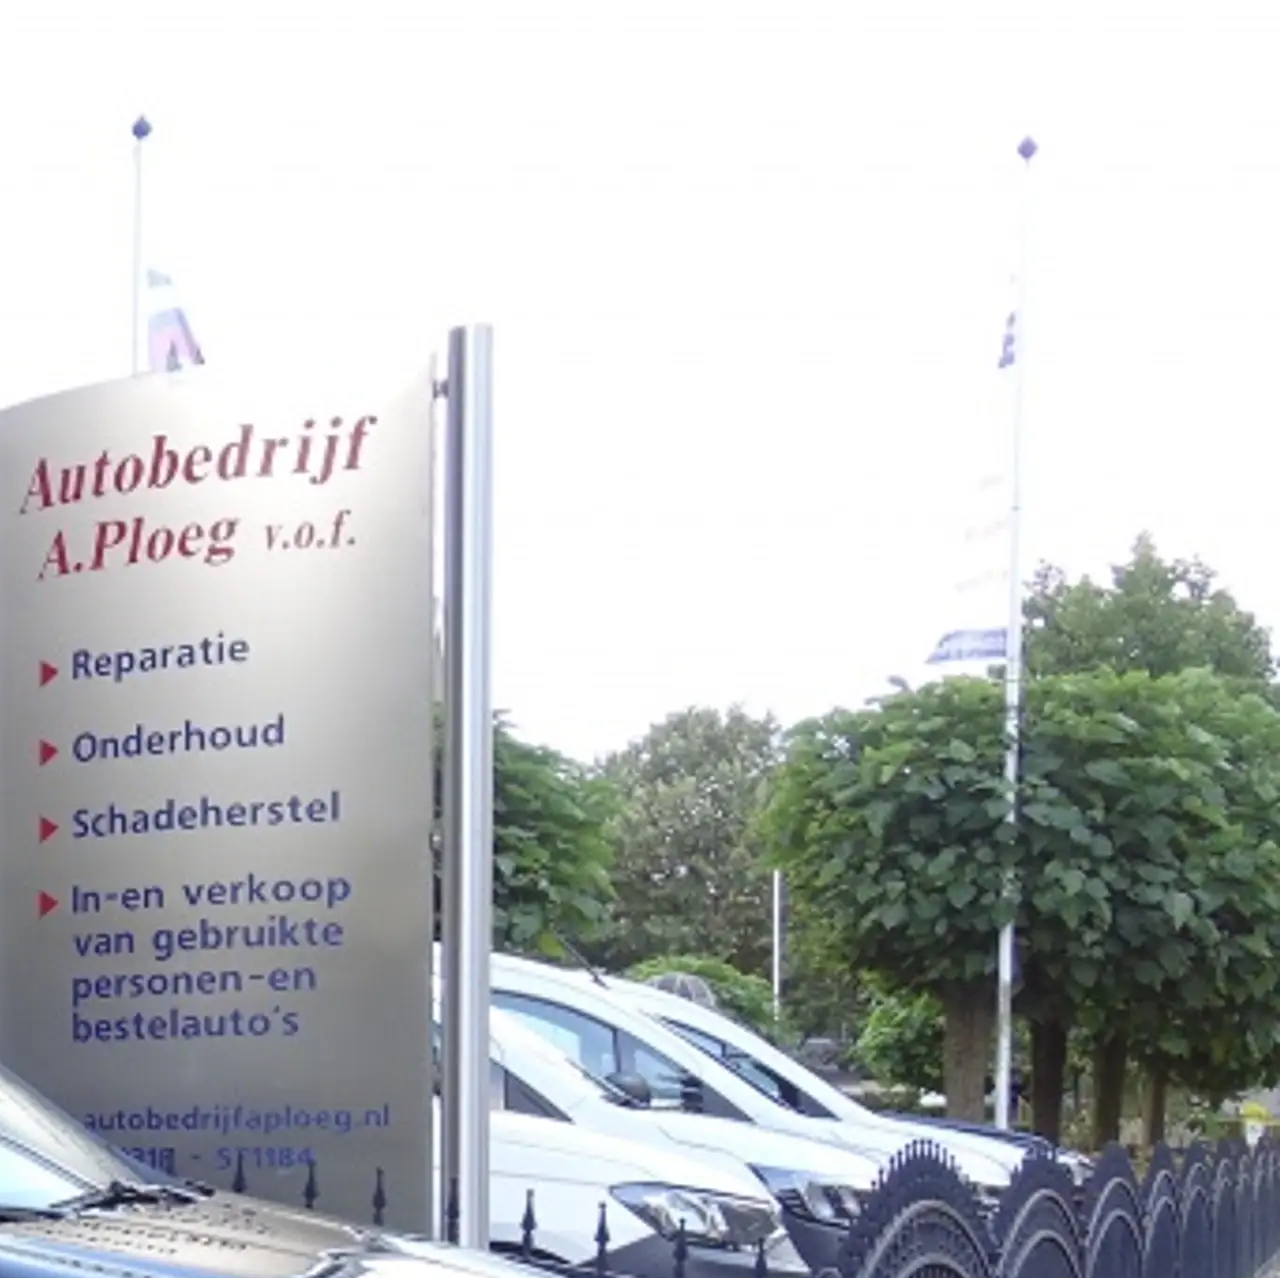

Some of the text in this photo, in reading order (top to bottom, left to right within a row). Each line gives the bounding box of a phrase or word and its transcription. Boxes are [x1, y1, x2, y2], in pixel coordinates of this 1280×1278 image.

[20, 416, 378, 514] Autobedrijf
[37, 510, 357, 581] A.Ploeg v.o.f.
[71, 633, 250, 683] Reparatie
[72, 714, 285, 763] Onderhoud
[71, 790, 341, 839] Schadeherstel
[71, 873, 352, 913] In-en verkoop
[72, 917, 345, 961] van gebruikte
[71, 962, 317, 1006] personen-en
[71, 1005, 300, 1043] bestelauto's
